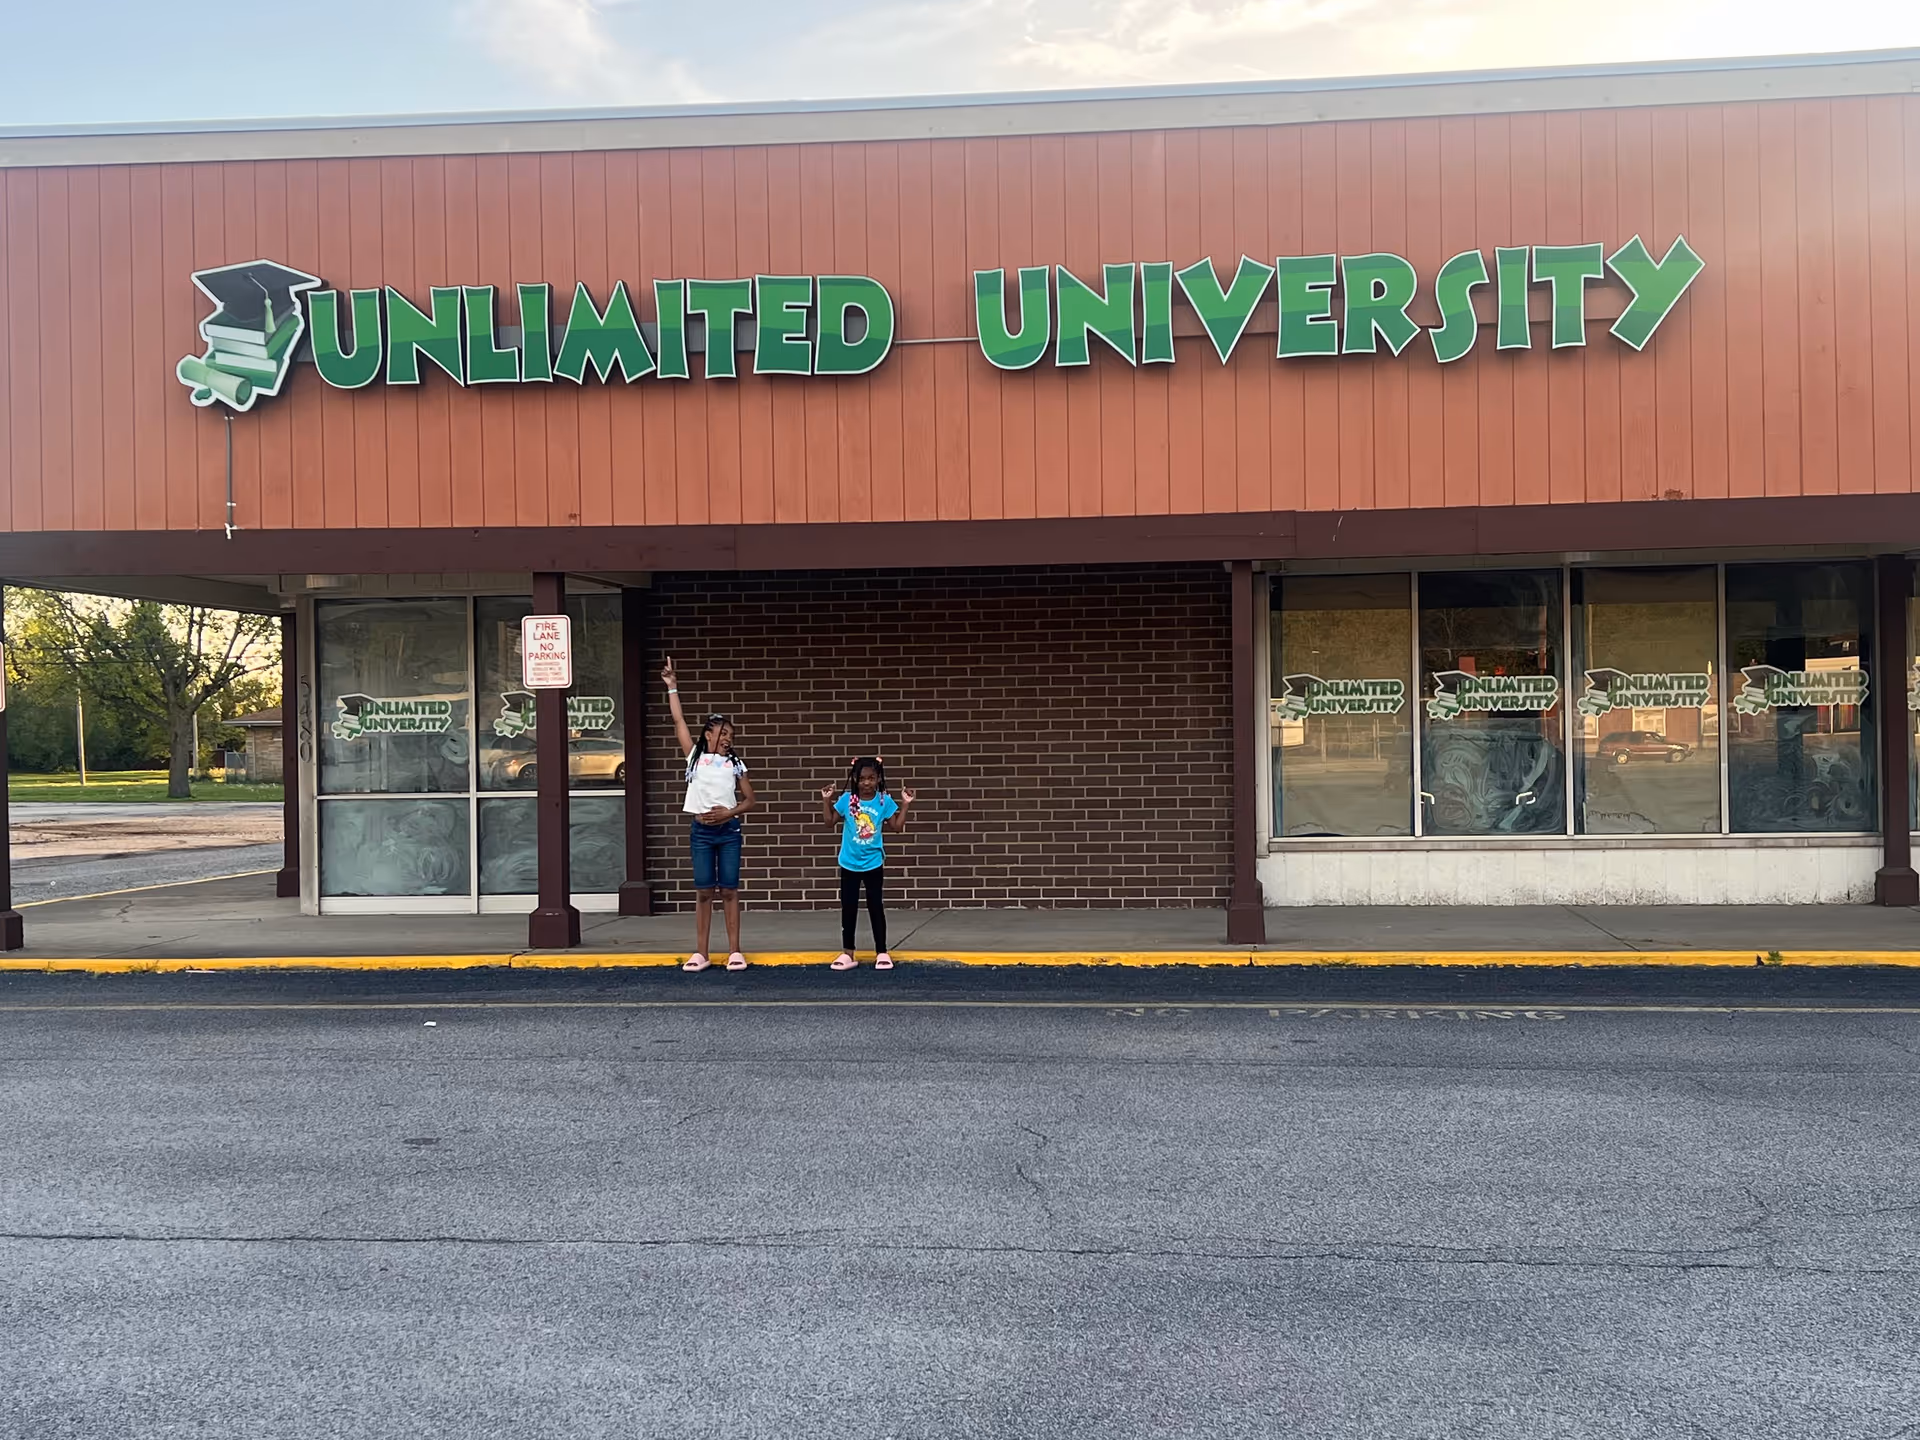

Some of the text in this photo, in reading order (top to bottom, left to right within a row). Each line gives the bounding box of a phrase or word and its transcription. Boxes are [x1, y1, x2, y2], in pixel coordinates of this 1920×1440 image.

[307, 233, 1706, 389] UNLIMITED UNIVERSITY
[535, 622, 557, 630] FIRE
[533, 632, 560, 640] LANE
[540, 643, 554, 651] NO
[528, 652, 566, 660] PARKING
[1462, 678, 1555, 693] UNLIMITED
[1612, 676, 1708, 690] UNLIMITED
[1769, 672, 1867, 687] UNLIMITED
[1309, 681, 1402, 696] UNLIMITED
[1462, 694, 1556, 709] UNIVERSITY
[1613, 692, 1709, 707] UNIVERSITY
[1770, 688, 1867, 704] UNIVERSITY
[363, 701, 449, 715] UNLIMITED
[526, 698, 611, 713] UMITED
[1310, 698, 1403, 712] UNIVERSITY
[364, 716, 449, 730] UNIVERSITY
[526, 713, 612, 729] URSITY
[1105, 1007, 1566, 1020] NO PARKING
